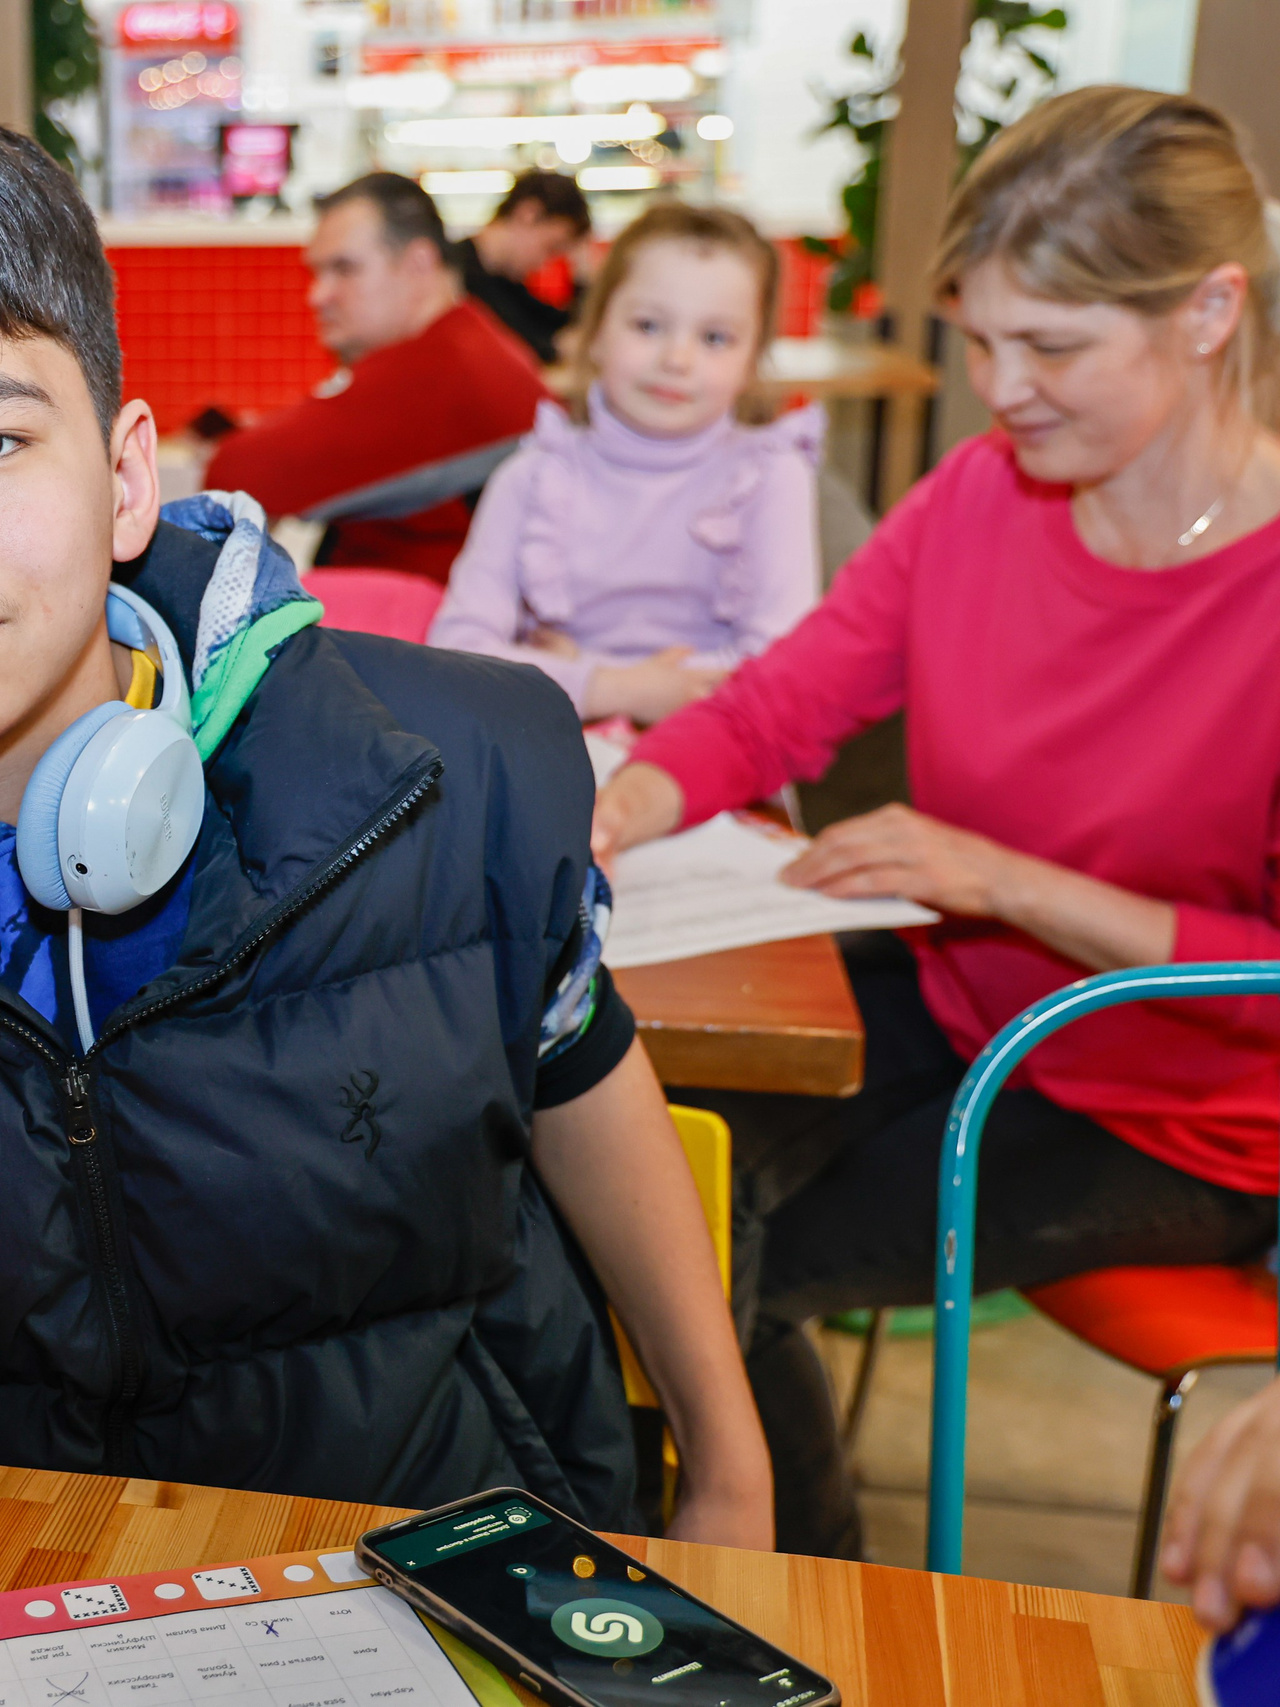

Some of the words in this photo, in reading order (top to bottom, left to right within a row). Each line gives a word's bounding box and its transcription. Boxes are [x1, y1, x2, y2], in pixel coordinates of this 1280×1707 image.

[166, 1628, 198, 1636] Билан
[200, 1624, 226, 1632] Дима
[90, 1634, 156, 1648] Шуфутински
[30, 1645, 64, 1654] дождя
[106, 1644, 146, 1653] Михаил
[30, 1654, 48, 1662] дня
[288, 1655, 324, 1664] Братья
[198, 1664, 235, 1672] Тролль
[107, 1672, 174, 1686] Белорусских
[202, 1671, 237, 1680] Мумий
[130, 1682, 158, 1690] Тима
[46, 1689, 85, 1698] Лоита
[370, 1687, 414, 1698] Кар-Мэн
